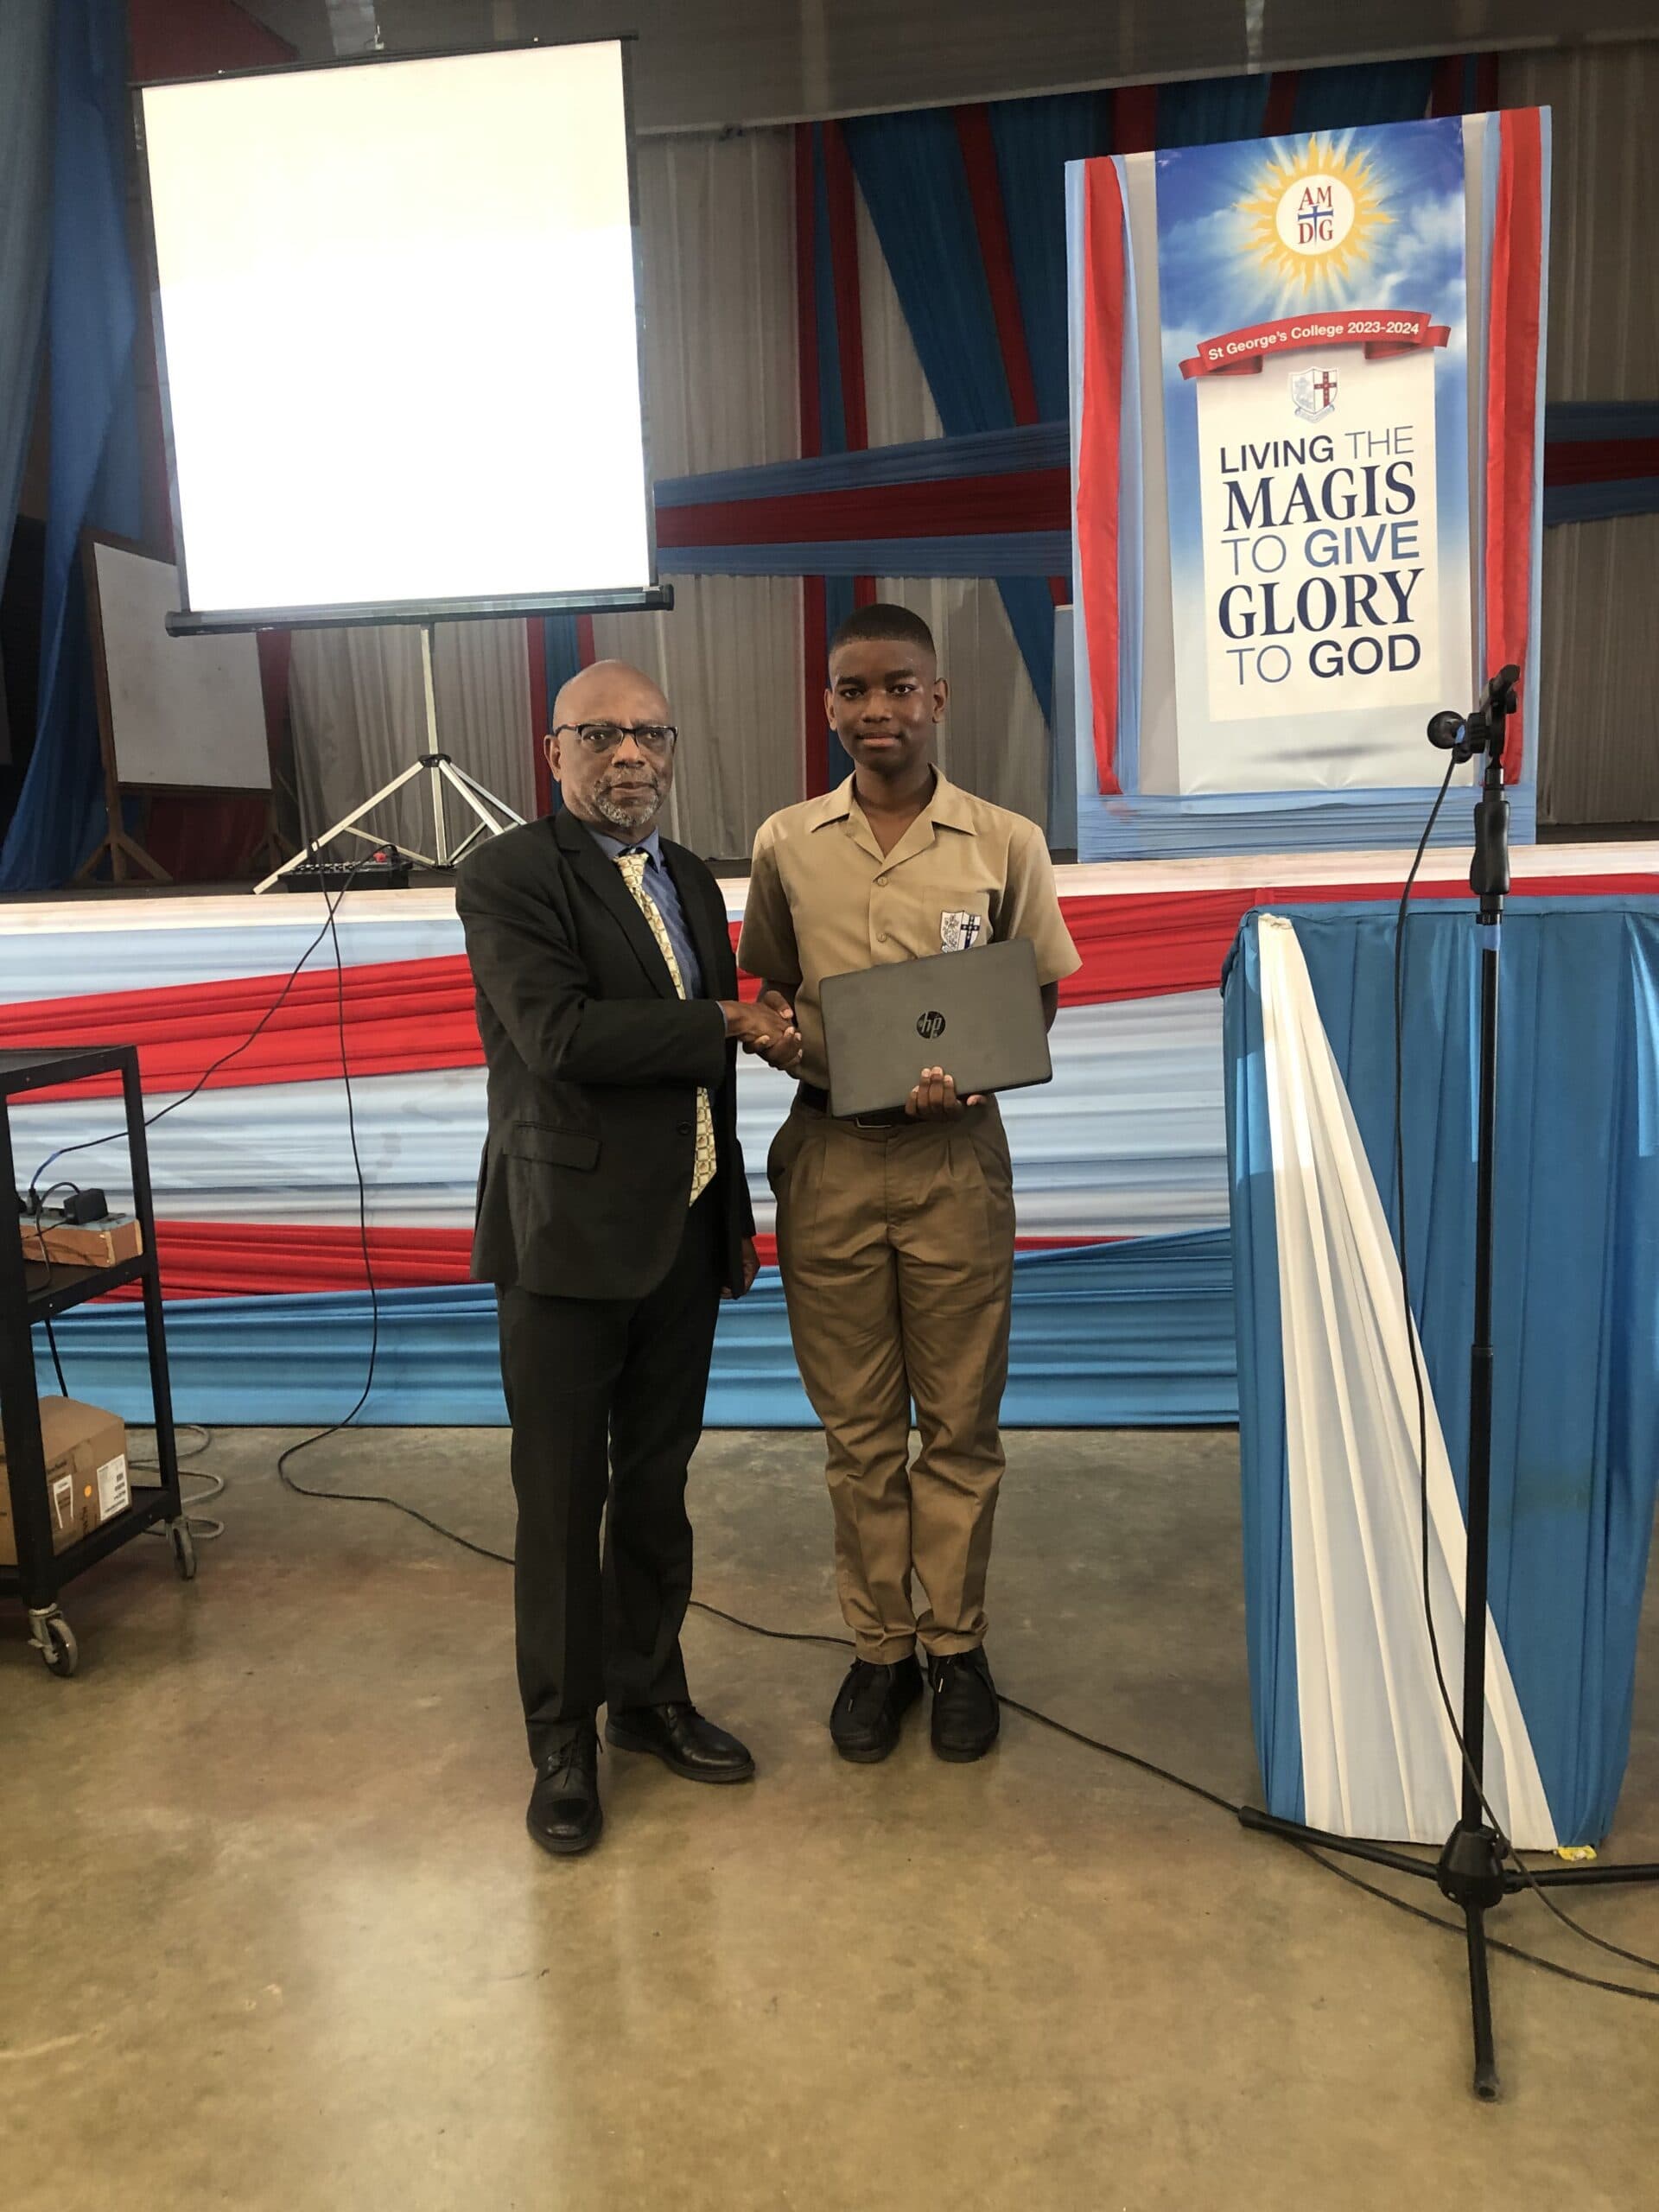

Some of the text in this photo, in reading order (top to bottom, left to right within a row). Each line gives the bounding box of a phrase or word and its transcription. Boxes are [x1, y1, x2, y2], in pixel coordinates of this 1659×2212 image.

[1298, 186, 1333, 211] AM
[1298, 219, 1333, 245] DG
[1208, 321, 1420, 361] St George's College 2023-2024
[1220, 425, 1414, 474] LIVING THE
[1223, 461, 1416, 532] MAGIS
[1221, 520, 1420, 575] TO GIVE
[1217, 568, 1425, 639] GLORY
[1226, 633, 1421, 685] TO GOD
[920, 1011, 942, 1039] hp
